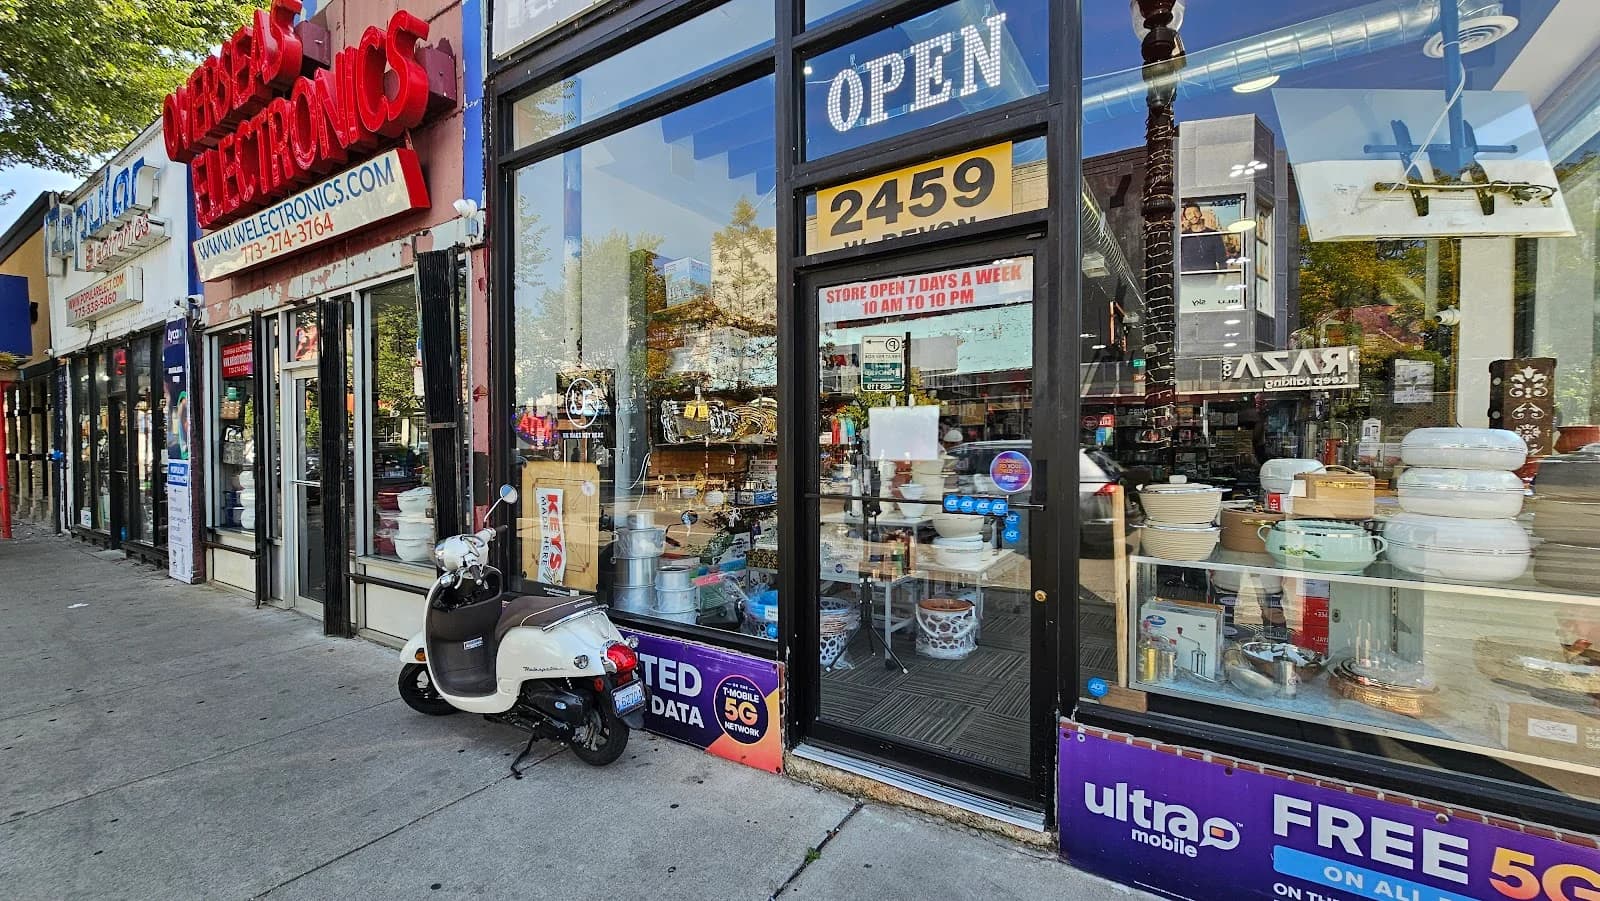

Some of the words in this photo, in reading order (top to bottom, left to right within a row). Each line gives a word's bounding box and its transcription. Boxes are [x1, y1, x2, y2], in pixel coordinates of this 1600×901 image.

[163, 0, 302, 161] OVERSEAS
[827, 13, 1007, 133] OPEN
[191, 9, 430, 229] ELECTRONICS
[196, 156, 396, 262] WWW.WELECTRONICS.COM
[830, 157, 996, 236] 2459
[240, 211, 334, 265] 773-274-3764
[826, 285, 867, 304] STORE
[870, 280, 905, 299] OPEN
[908, 279, 917, 294] 7
[919, 273, 957, 292] DAYS
[961, 271, 972, 287] A
[975, 263, 1022, 285] WEEK
[863, 300, 878, 315] 10
[880, 297, 902, 314] AM
[906, 294, 923, 311] TO
[927, 292, 946, 308] 10
[950, 288, 974, 305] PM
[546, 494, 563, 570] KEYS
[639, 652, 702, 697] TED
[722, 686, 760, 704] T-MOBILE
[651, 694, 704, 729] DATA
[724, 697, 758, 726] 5G
[724, 721, 760, 738] NETWORK
[1084, 781, 1199, 842] ultra
[1131, 828, 1198, 858] mobile
[1272, 793, 1469, 885] FREE
[1488, 846, 1600, 901] 5G
[1272, 882, 1301, 900] ON
[1305, 890, 1341, 901] TH
[1323, 865, 1364, 889] ON
